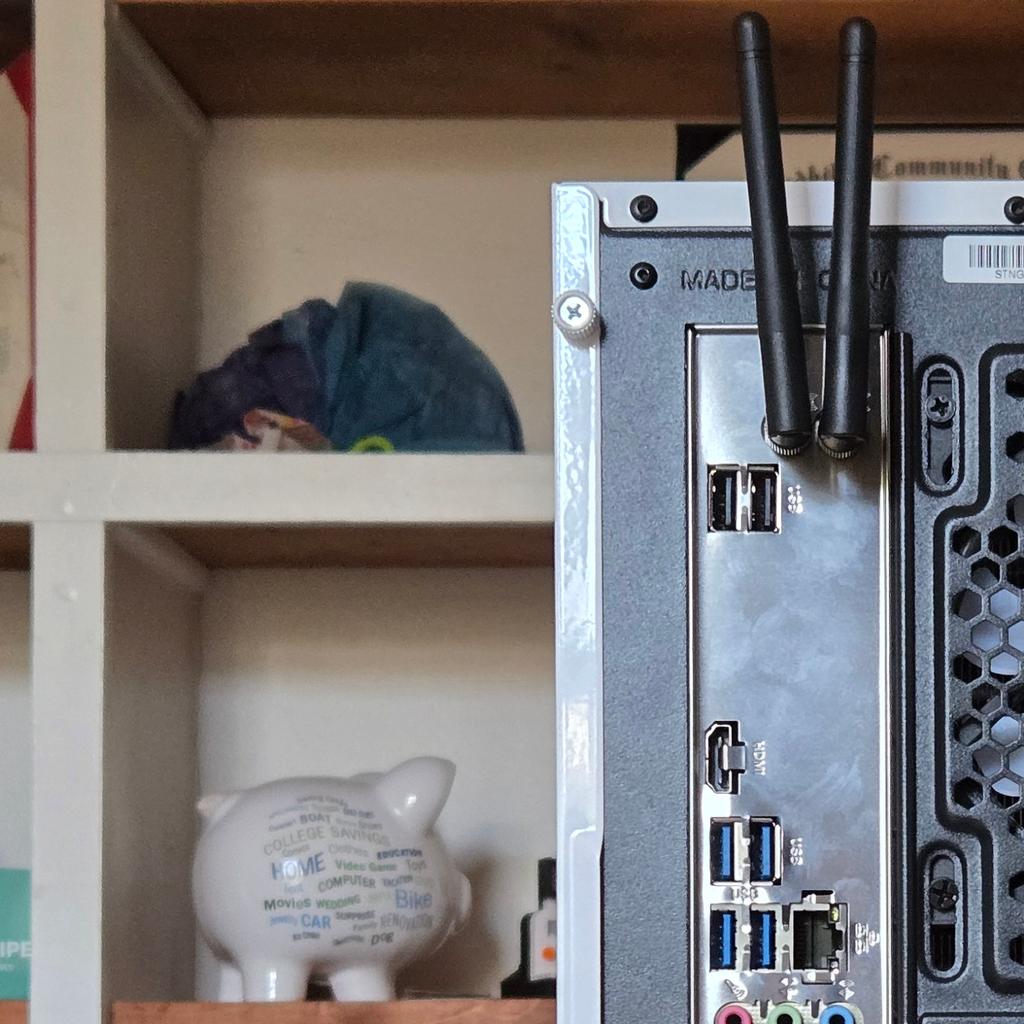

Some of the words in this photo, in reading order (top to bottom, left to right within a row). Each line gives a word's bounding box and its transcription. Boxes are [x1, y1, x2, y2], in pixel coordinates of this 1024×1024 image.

[680, 269, 756, 291] MADE
[752, 741, 766, 775] HDMI
[299, 812, 331, 825] BOAT
[264, 826, 326, 855] COLLEGE
[330, 825, 391, 847] SAVINGS
[789, 838, 804, 866] USB
[271, 852, 326, 880] HOME
[335, 859, 366, 871] Video
[318, 875, 376, 893] COMPUTER
[264, 897, 311, 911] Movies
[395, 888, 433, 910] Bike
[301, 913, 332, 929] CAR
